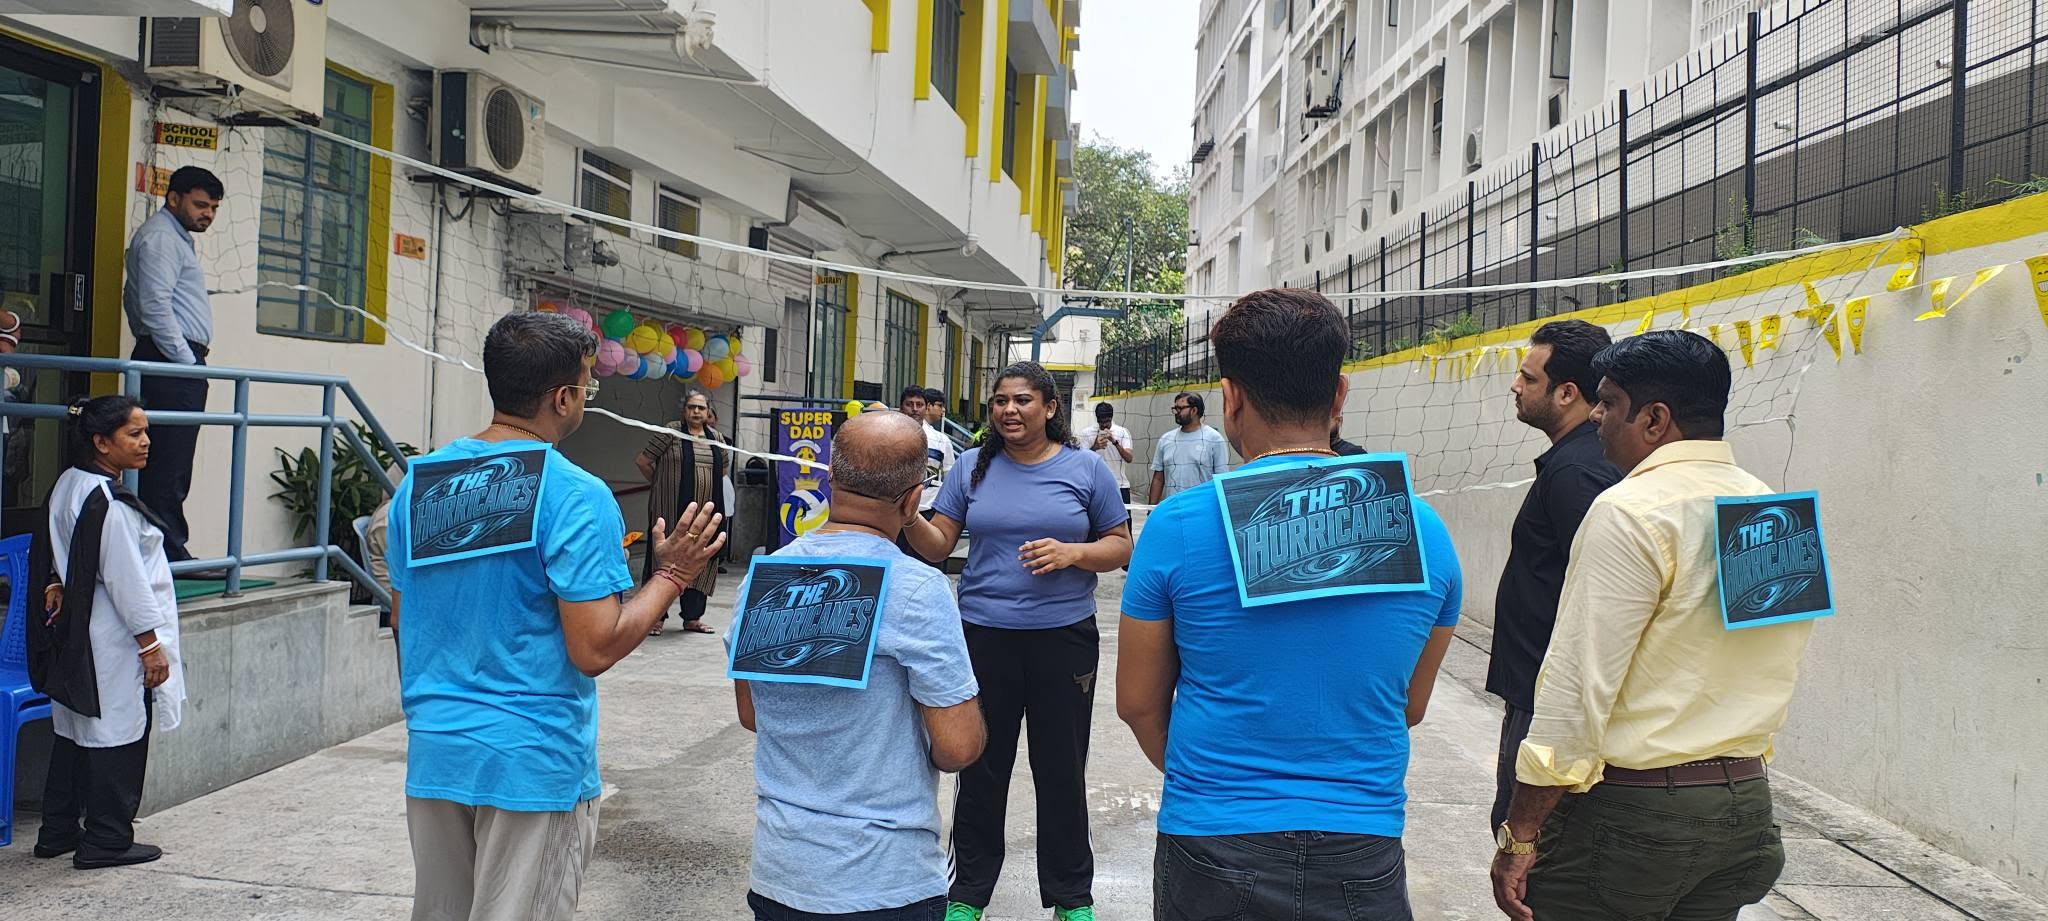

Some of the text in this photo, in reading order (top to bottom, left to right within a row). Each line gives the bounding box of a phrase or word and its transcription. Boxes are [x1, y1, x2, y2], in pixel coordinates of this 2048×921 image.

[163, 123, 216, 138] SCHOOL
[165, 135, 212, 147] OFFICE
[780, 411, 833, 425] SUPER
[790, 425, 825, 439] DAD
[447, 469, 495, 496] THE
[414, 475, 538, 546] HURRICANES
[1283, 481, 1347, 518] THE
[1246, 495, 1407, 581] HURRICANES
[1739, 520, 1773, 550] THE
[1723, 530, 1818, 606] HURRICANES
[785, 582, 829, 608] THE
[738, 598, 874, 656] HURRICANES
